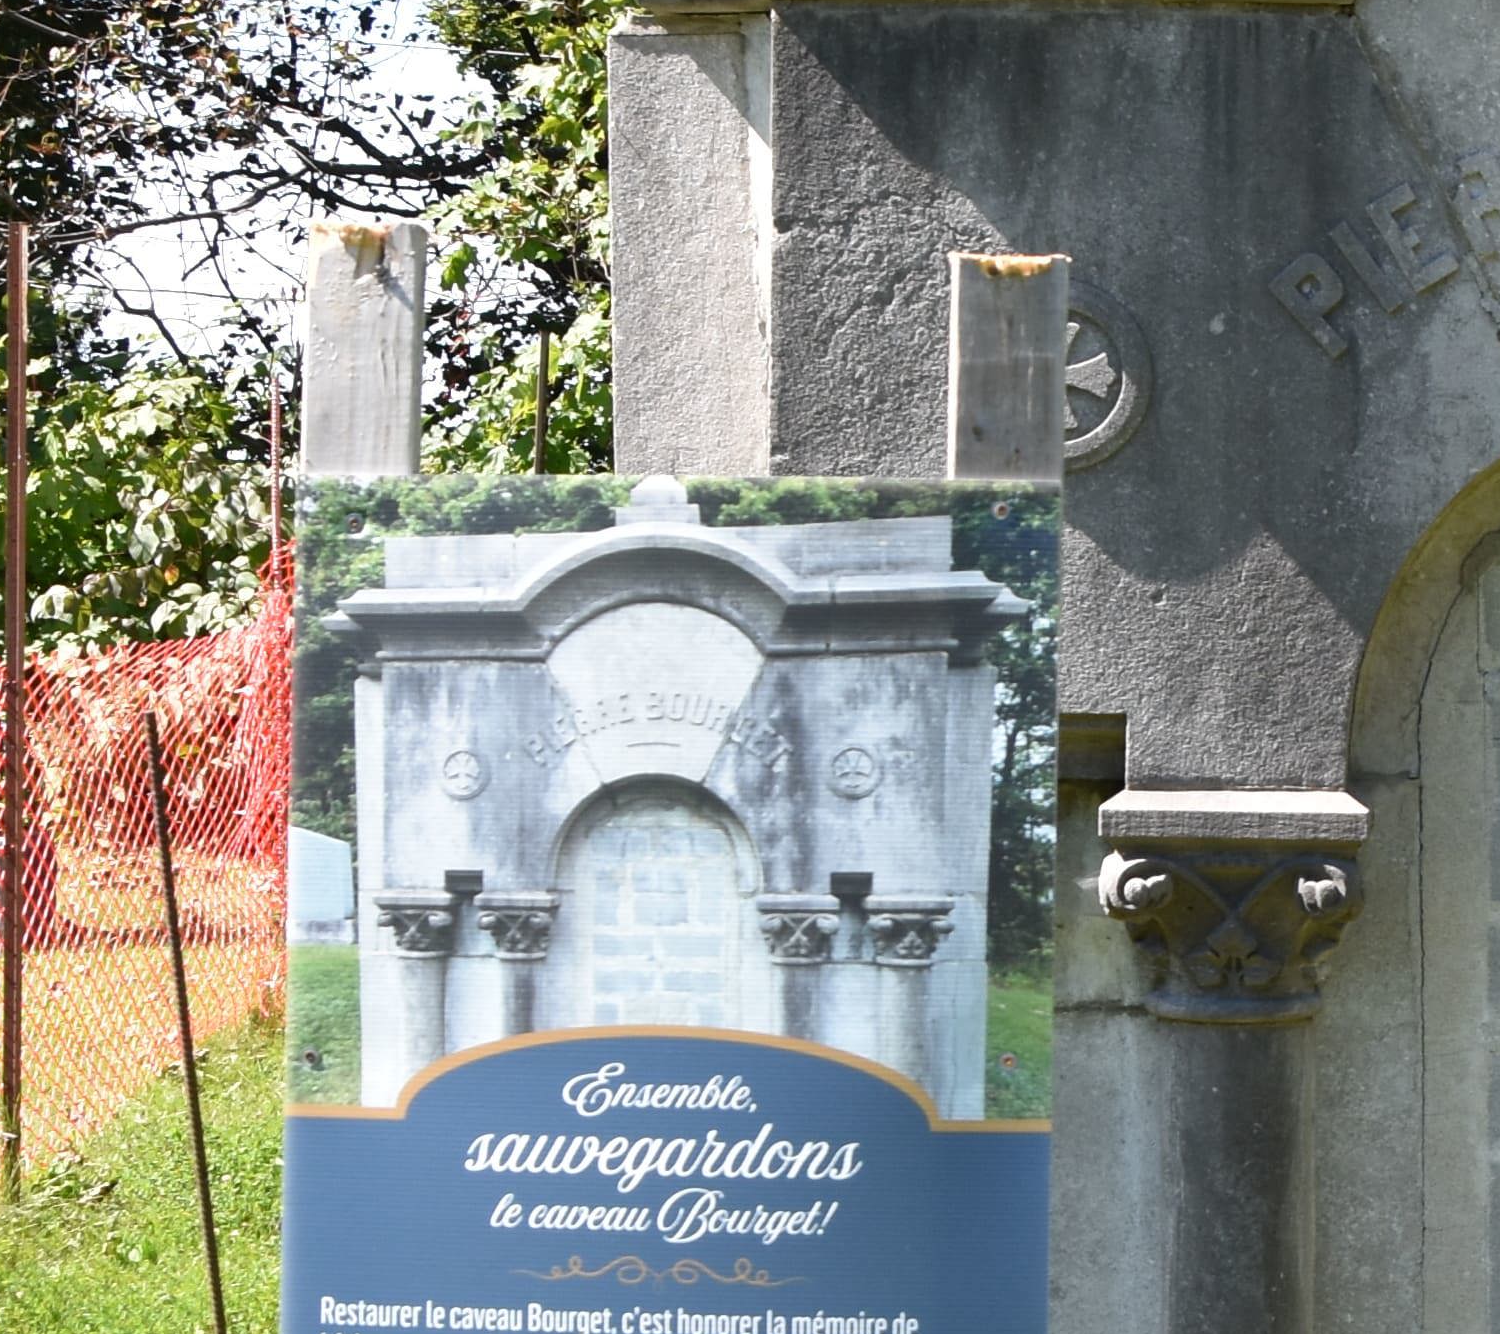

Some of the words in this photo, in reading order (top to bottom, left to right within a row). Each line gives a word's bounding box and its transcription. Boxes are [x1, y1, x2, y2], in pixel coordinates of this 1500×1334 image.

[527, 693, 637, 768] PIERRE
[562, 1062, 758, 1118] Ensemble,
[464, 1123, 864, 1194] sauvegardons
[489, 1193, 523, 1229] le
[528, 1201, 653, 1233] caveau
[656, 1187, 840, 1246] Bourget!
[320, 1296, 422, 1328] Restaurer
[425, 1300, 445, 1329] le
[449, 1306, 523, 1332] caveau
